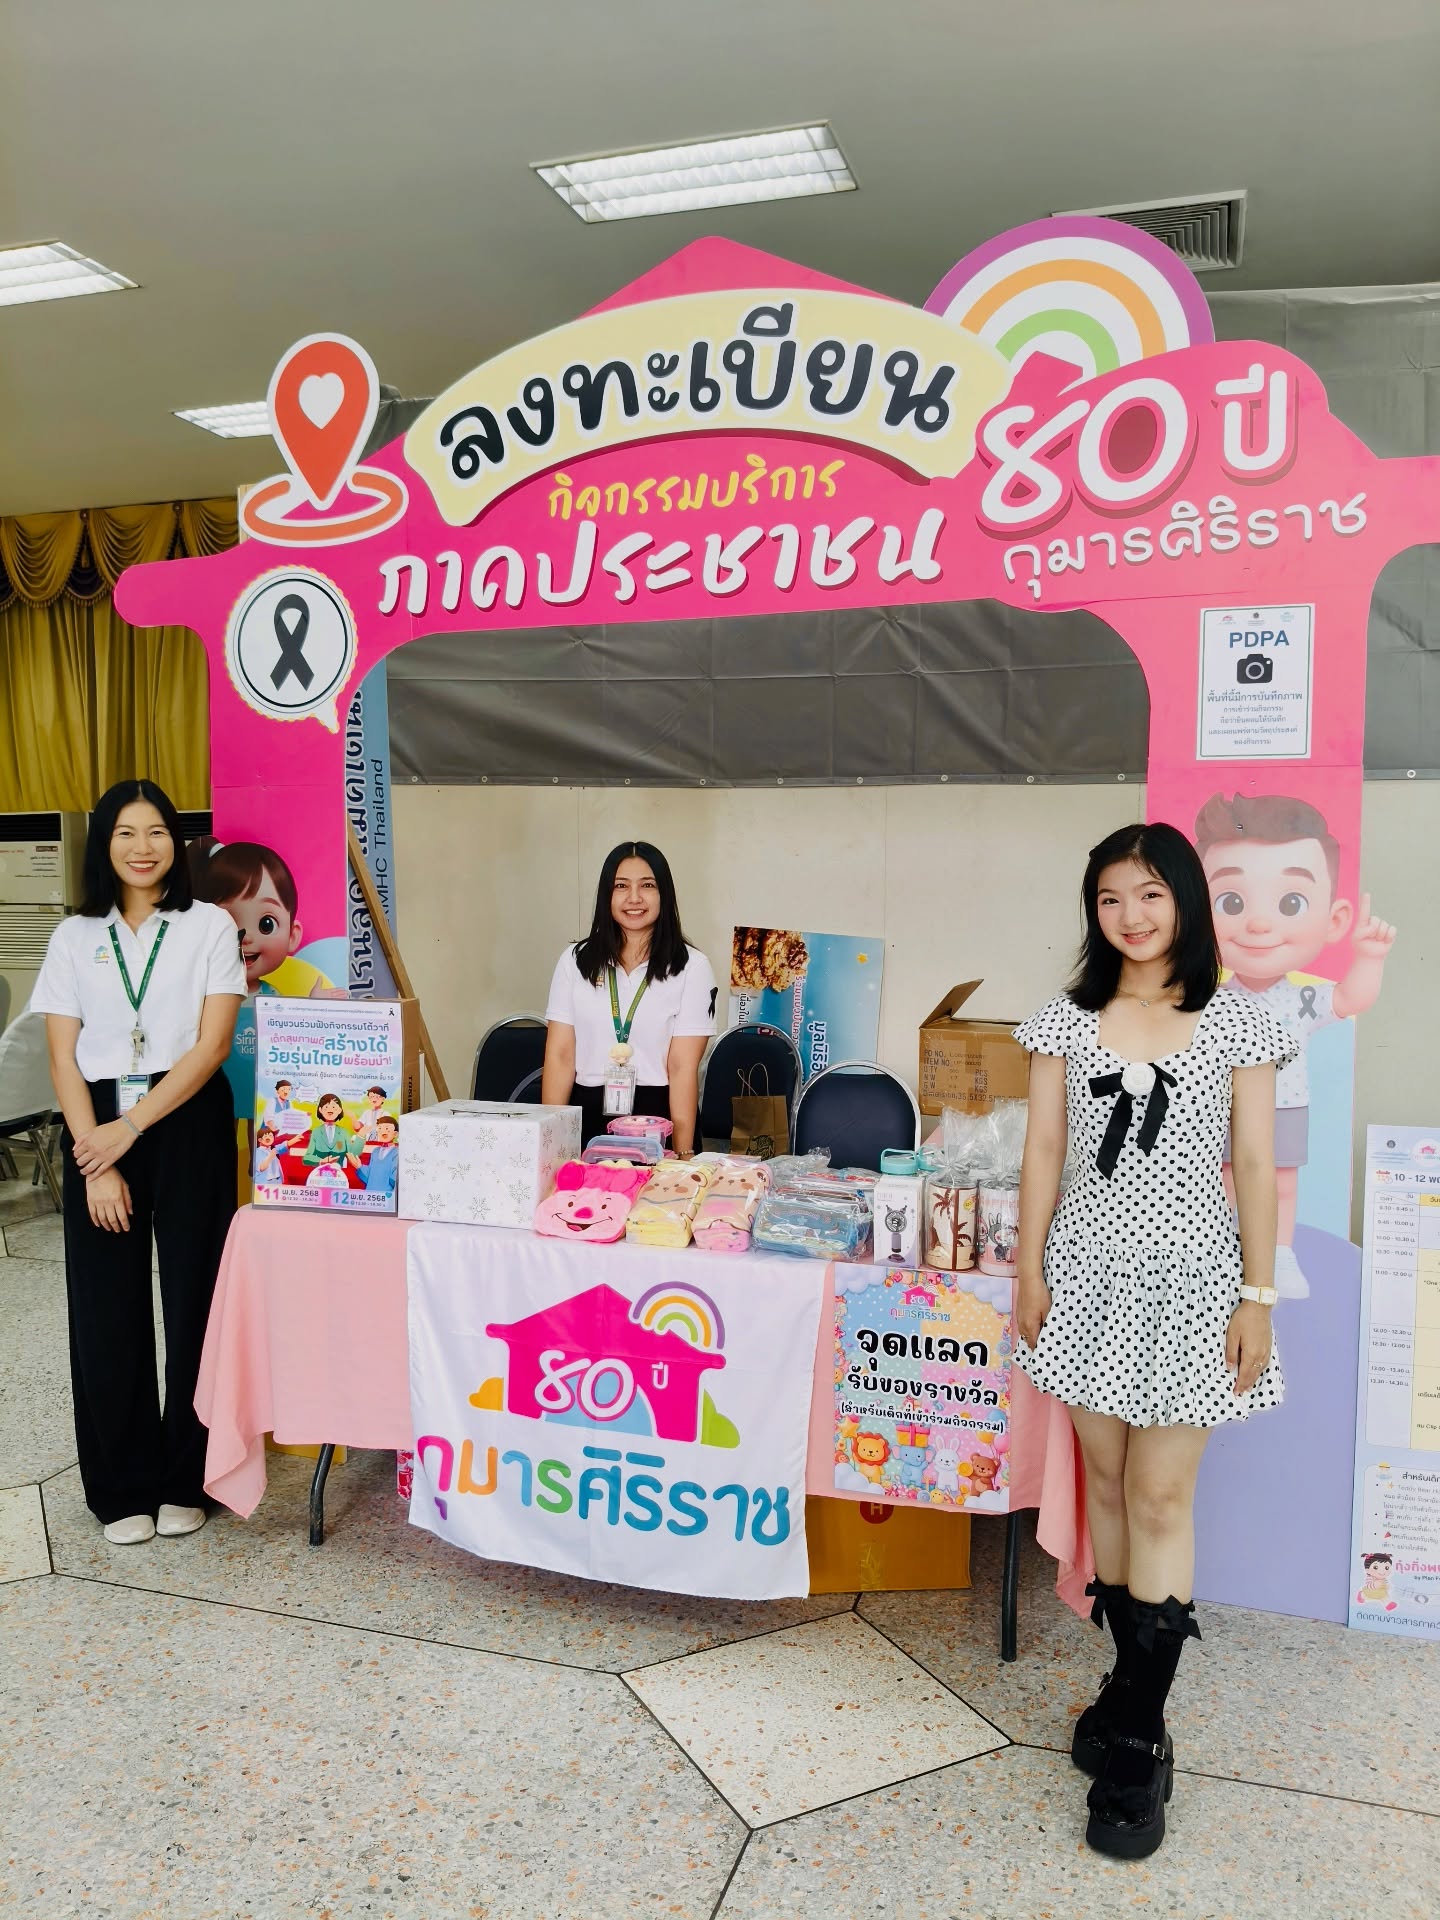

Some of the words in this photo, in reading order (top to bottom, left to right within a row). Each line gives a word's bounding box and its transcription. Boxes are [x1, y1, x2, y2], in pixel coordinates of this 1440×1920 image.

[440, 303, 955, 481] ลงทะเบียน
[1216, 363, 1288, 472] ปี
[549, 454, 840, 521] กิจกรรมบริการ
[379, 508, 947, 615] ภาคประชาชน
[1004, 492, 1368, 600] กุมารศิริราช
[1229, 630, 1290, 648] PDPA
[1207, 689, 1303, 702] พื้นที่นี้มีการบันทึกภาพ
[371, 758, 386, 850] Thailand
[375, 858, 390, 923] MHC
[269, 1046, 343, 1071] วัยรุ่นไทย
[324, 1033, 388, 1053] สร้างได้
[1394, 1173, 1406, 1182] 10
[1415, 1174, 1426, 1183] 12
[856, 1328, 988, 1371] จุดแลก
[534, 1349, 634, 1419] 80
[651, 1361, 669, 1390] ปี
[847, 1365, 998, 1406] รับของรางวัล
[841, 1401, 1005, 1434] (สำหรับเด็กที่เข้าร่วมกิจกรรม)
[416, 1434, 790, 1546] กุมารศิริราช
